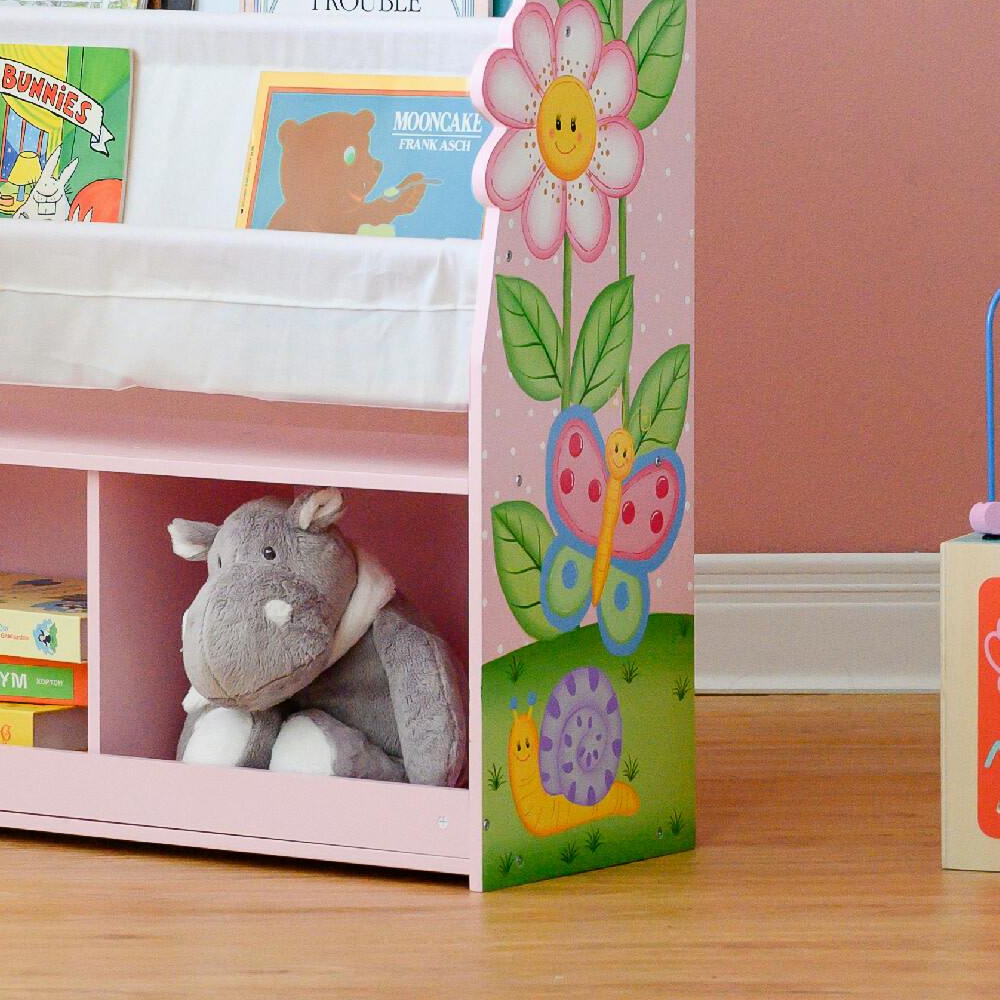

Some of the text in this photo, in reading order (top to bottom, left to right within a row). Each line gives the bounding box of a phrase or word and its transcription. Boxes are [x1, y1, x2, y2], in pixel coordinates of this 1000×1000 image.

[392, 111, 482, 132] MOONCAKE
[399, 138, 470, 152] FRANK ASCH
